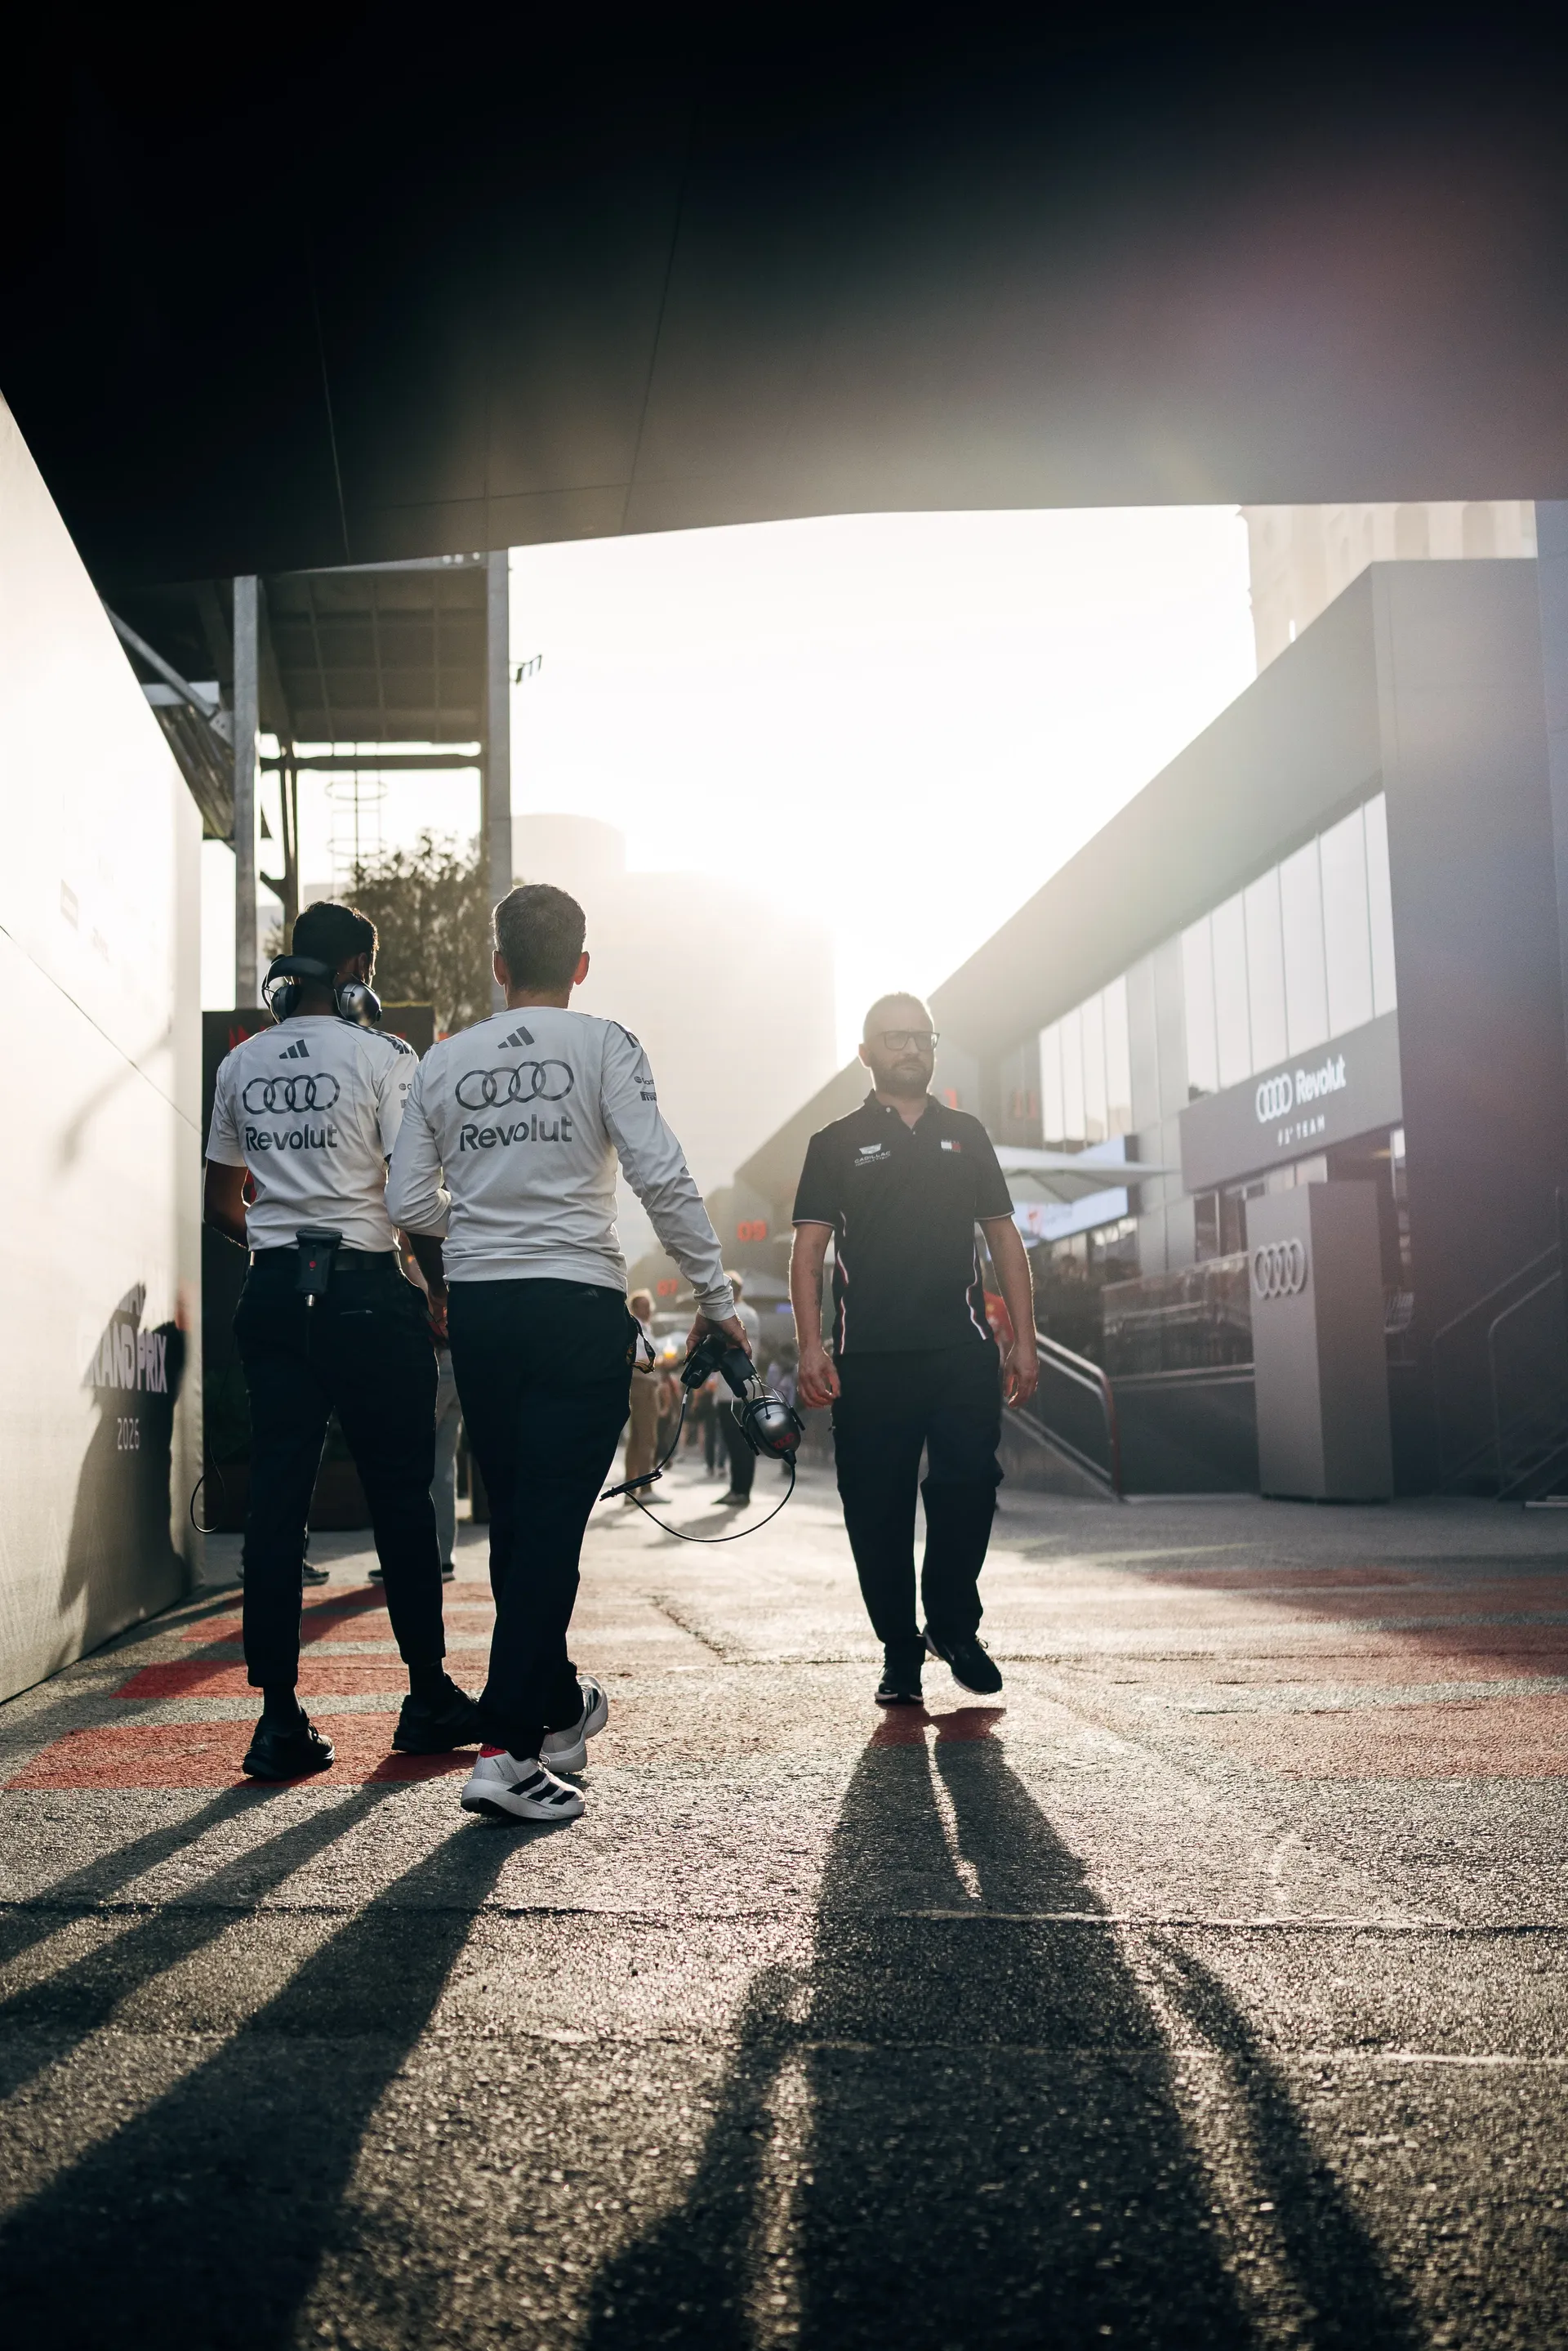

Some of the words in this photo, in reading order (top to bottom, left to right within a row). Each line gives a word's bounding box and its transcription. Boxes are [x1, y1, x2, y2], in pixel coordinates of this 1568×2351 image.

[1295, 1054, 1347, 1105] Revolut
[245, 1122, 337, 1151] Revolut
[460, 1113, 572, 1152] Revolut
[1296, 1113, 1325, 1140] TEAM
[854, 1150, 891, 1163] CADILLAC
[136, 1331, 167, 1394] PRIX
[118, 1417, 140, 1450] 2026
